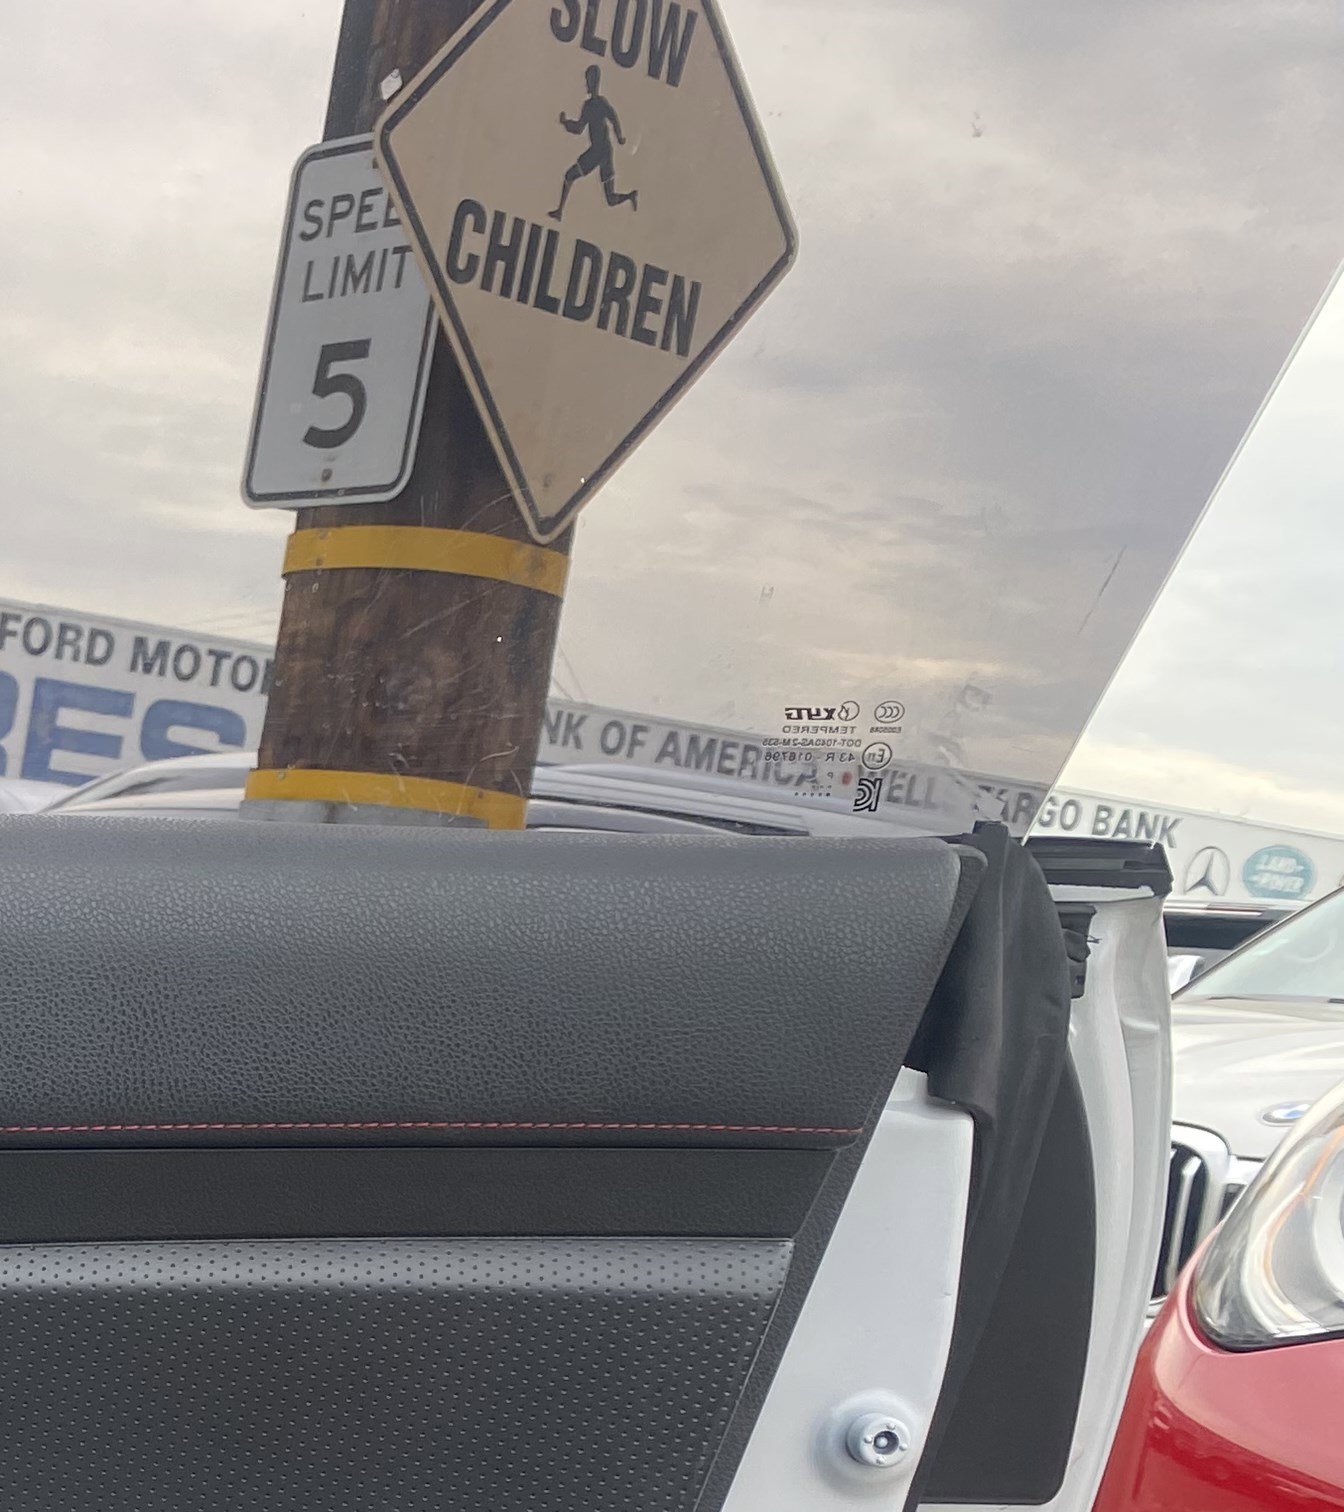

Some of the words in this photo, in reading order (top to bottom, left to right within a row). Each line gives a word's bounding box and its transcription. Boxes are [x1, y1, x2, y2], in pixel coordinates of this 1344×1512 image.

[549, 0, 699, 88] SLOW
[297, 185, 404, 243] SPEE
[301, 244, 414, 304] LIMIT
[444, 198, 704, 359] CHILDREN
[301, 337, 374, 450] 5
[128, 634, 276, 696] MOTO
[543, 703, 590, 750] NK
[599, 717, 650, 761] OF
[654, 731, 822, 788] AMERICA
[1091, 803, 1185, 849] BANK
